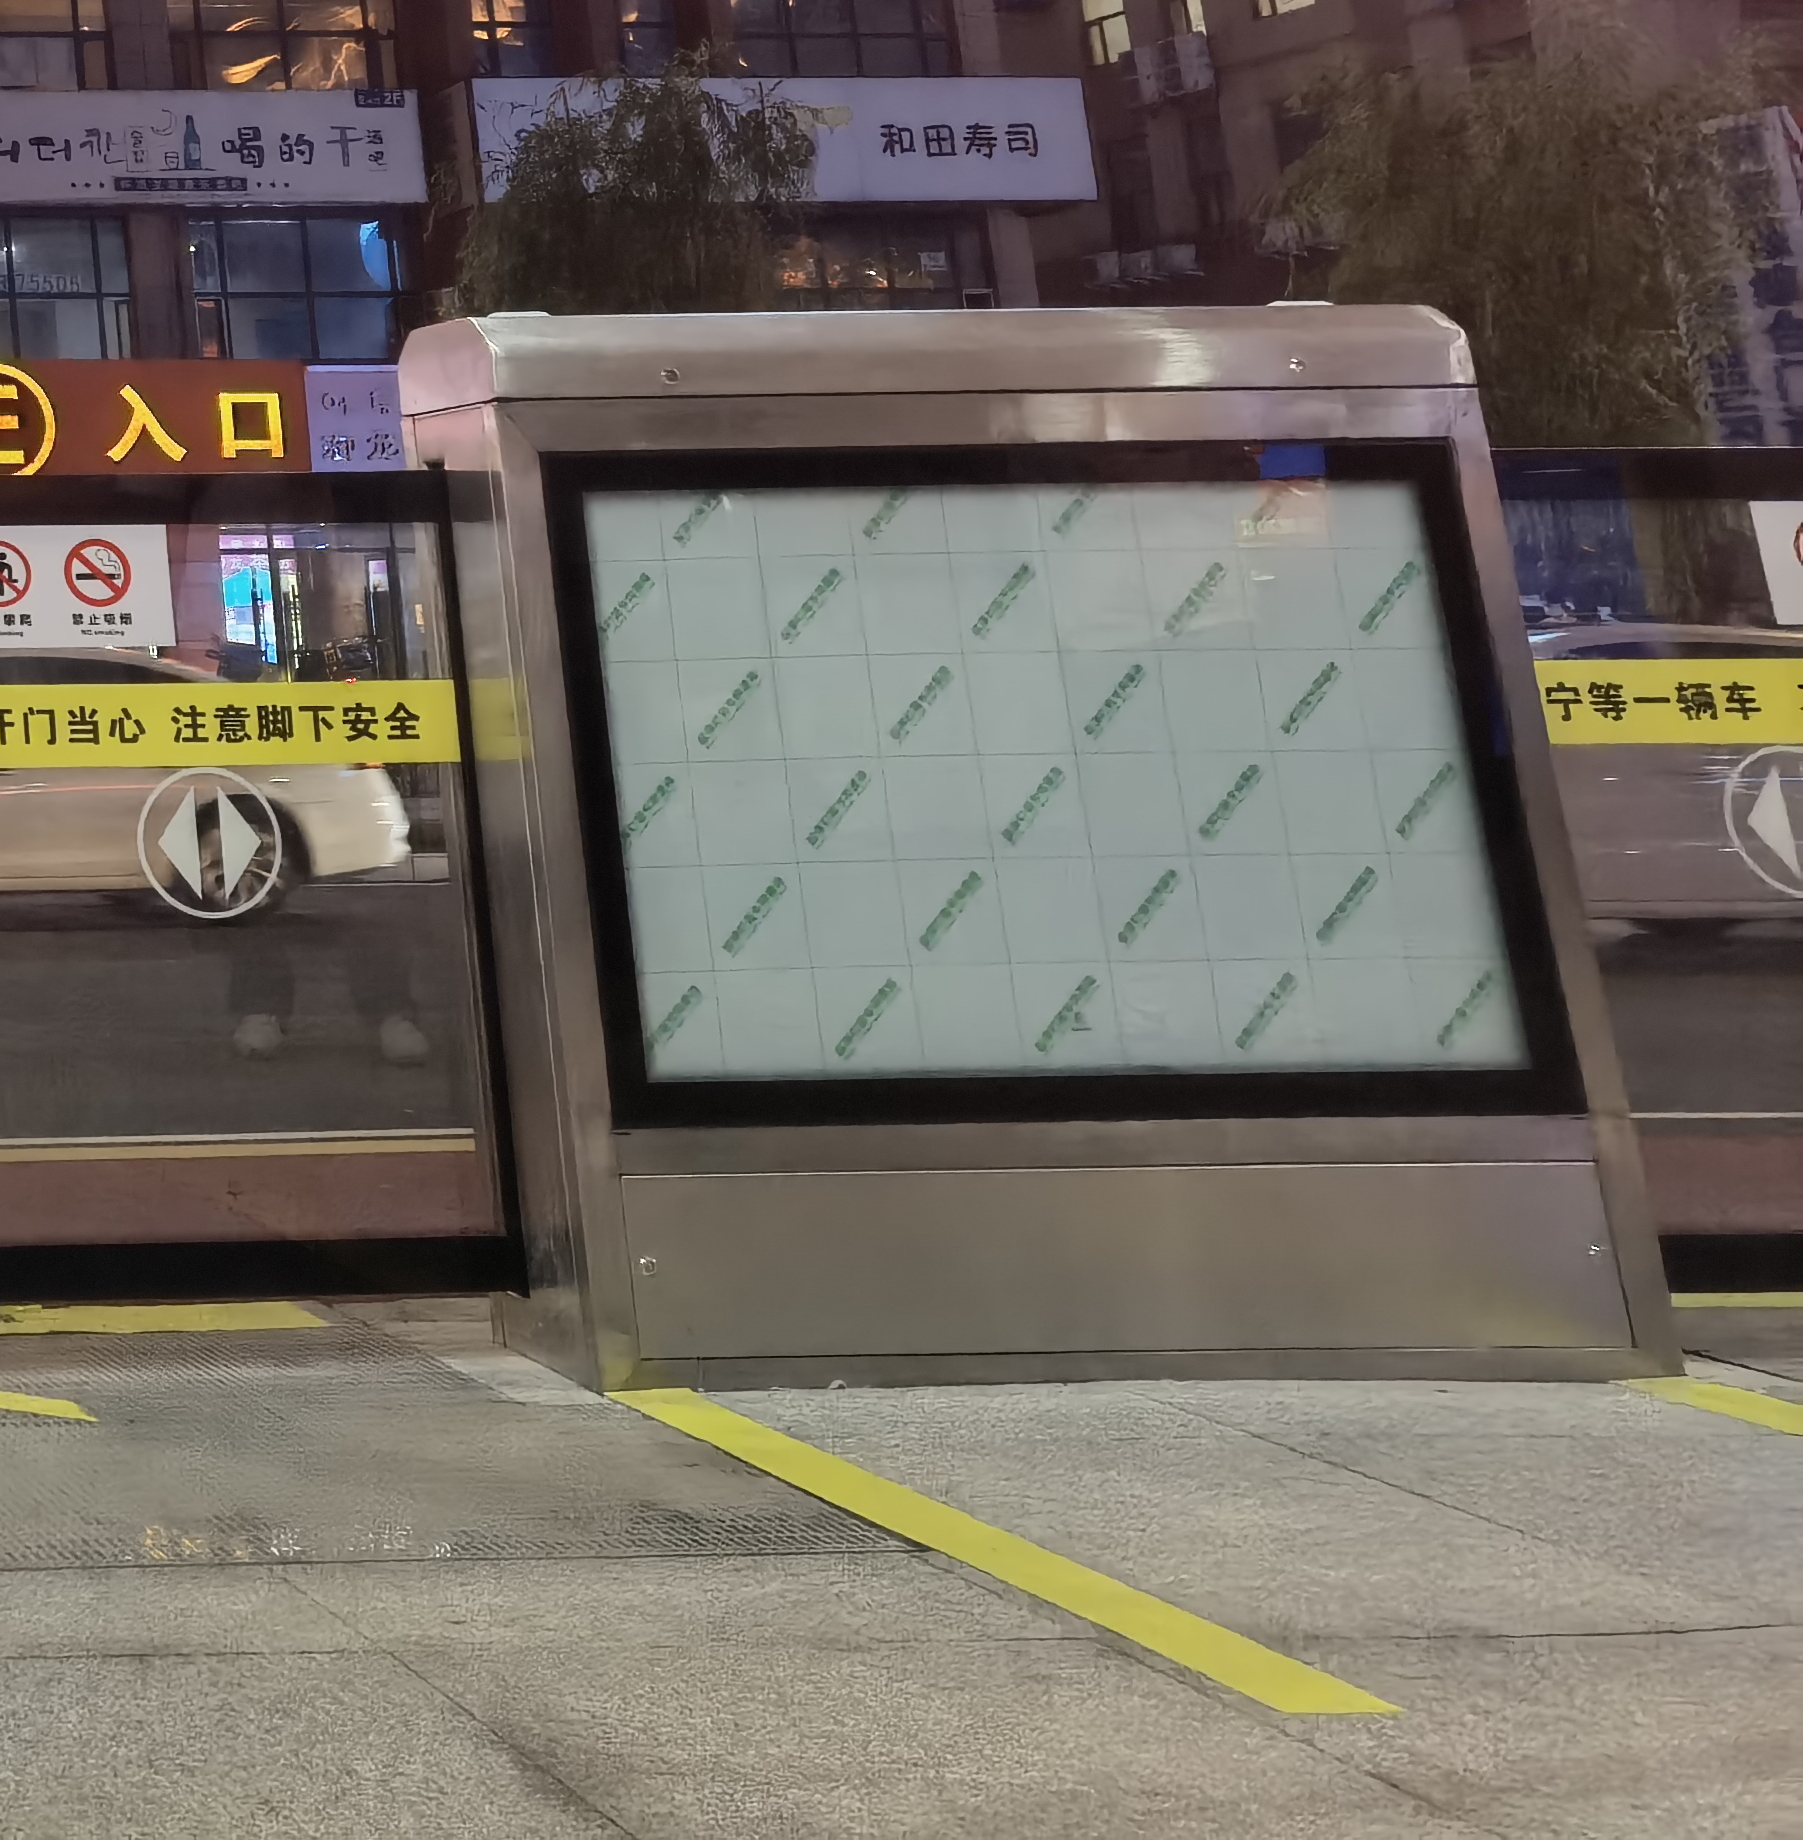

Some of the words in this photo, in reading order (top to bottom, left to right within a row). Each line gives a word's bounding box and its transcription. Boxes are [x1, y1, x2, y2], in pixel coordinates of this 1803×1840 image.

[879, 122, 1038, 159] 和田寿司
[104, 385, 284, 460] 入口
[72, 613, 133, 626] 禁止吸烟
[1545, 682, 1762, 721] 宁等一辆车
[171, 702, 423, 744] 注意脚下安全
